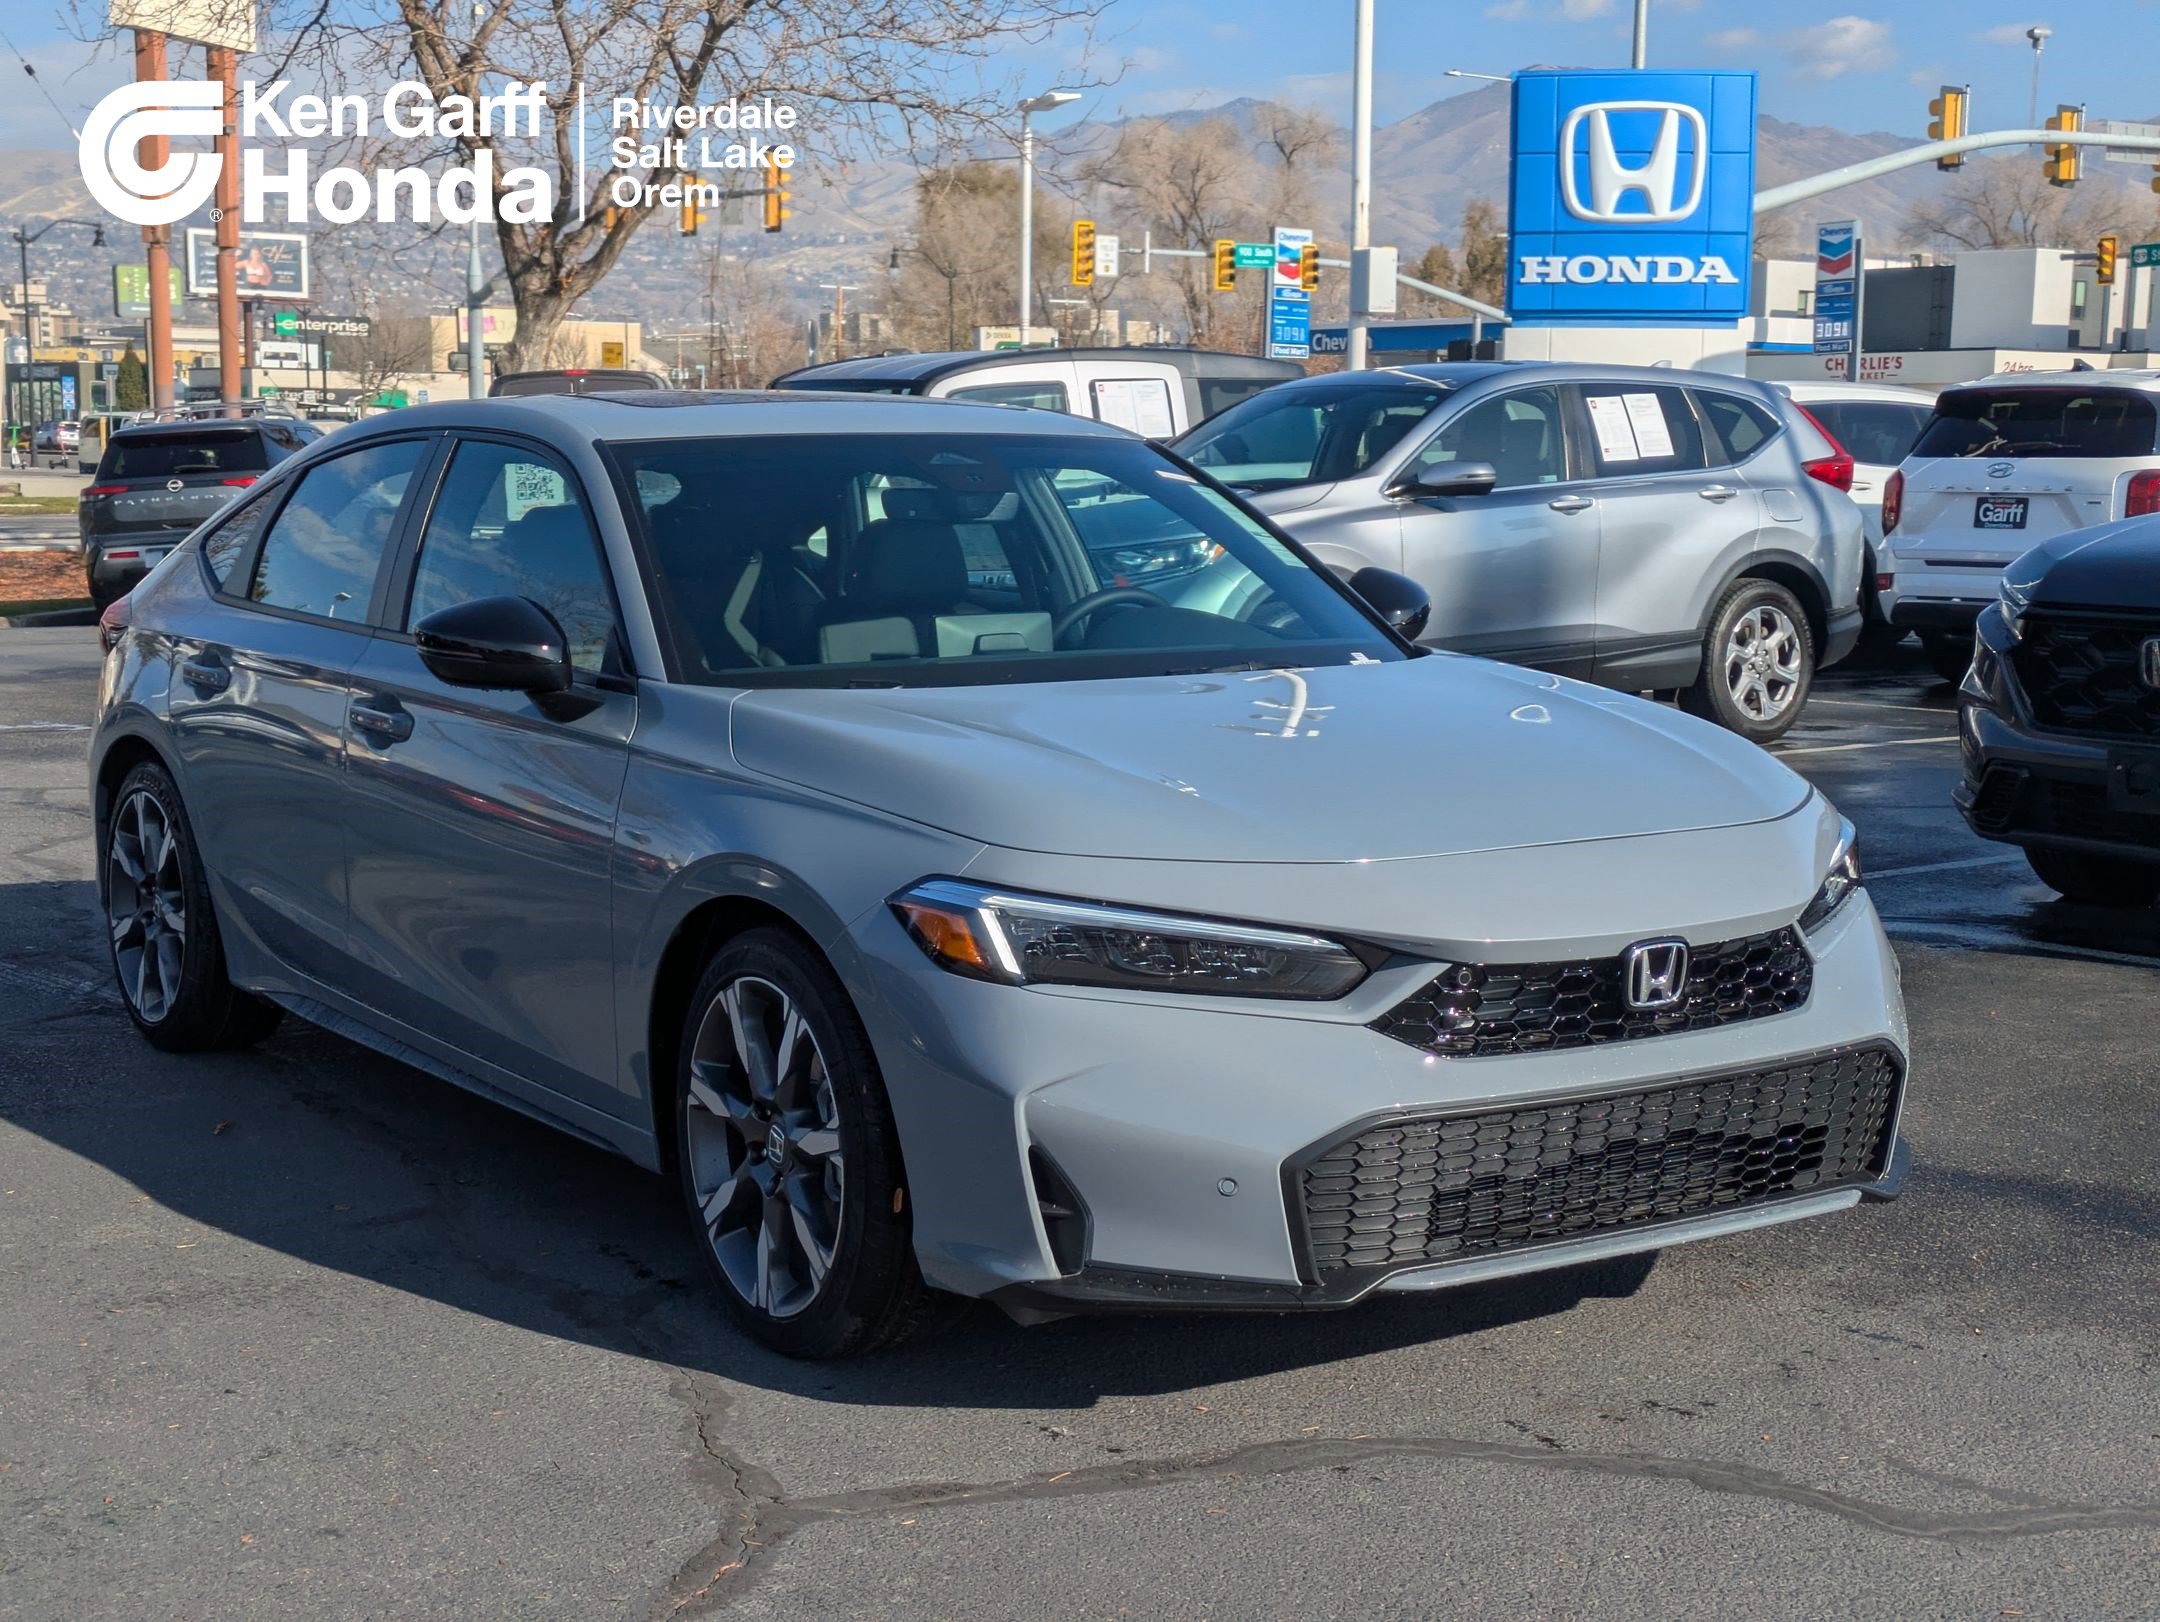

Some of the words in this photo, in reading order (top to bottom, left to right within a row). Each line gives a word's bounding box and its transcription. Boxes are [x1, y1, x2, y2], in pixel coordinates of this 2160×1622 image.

[1519, 255, 1740, 284] HONDA
[276, 319, 369, 334] enterprise
[1312, 333, 1373, 351] Chevn
[1825, 356, 1903, 371] CHRLIE'S
[1979, 503, 2024, 522] Garff
